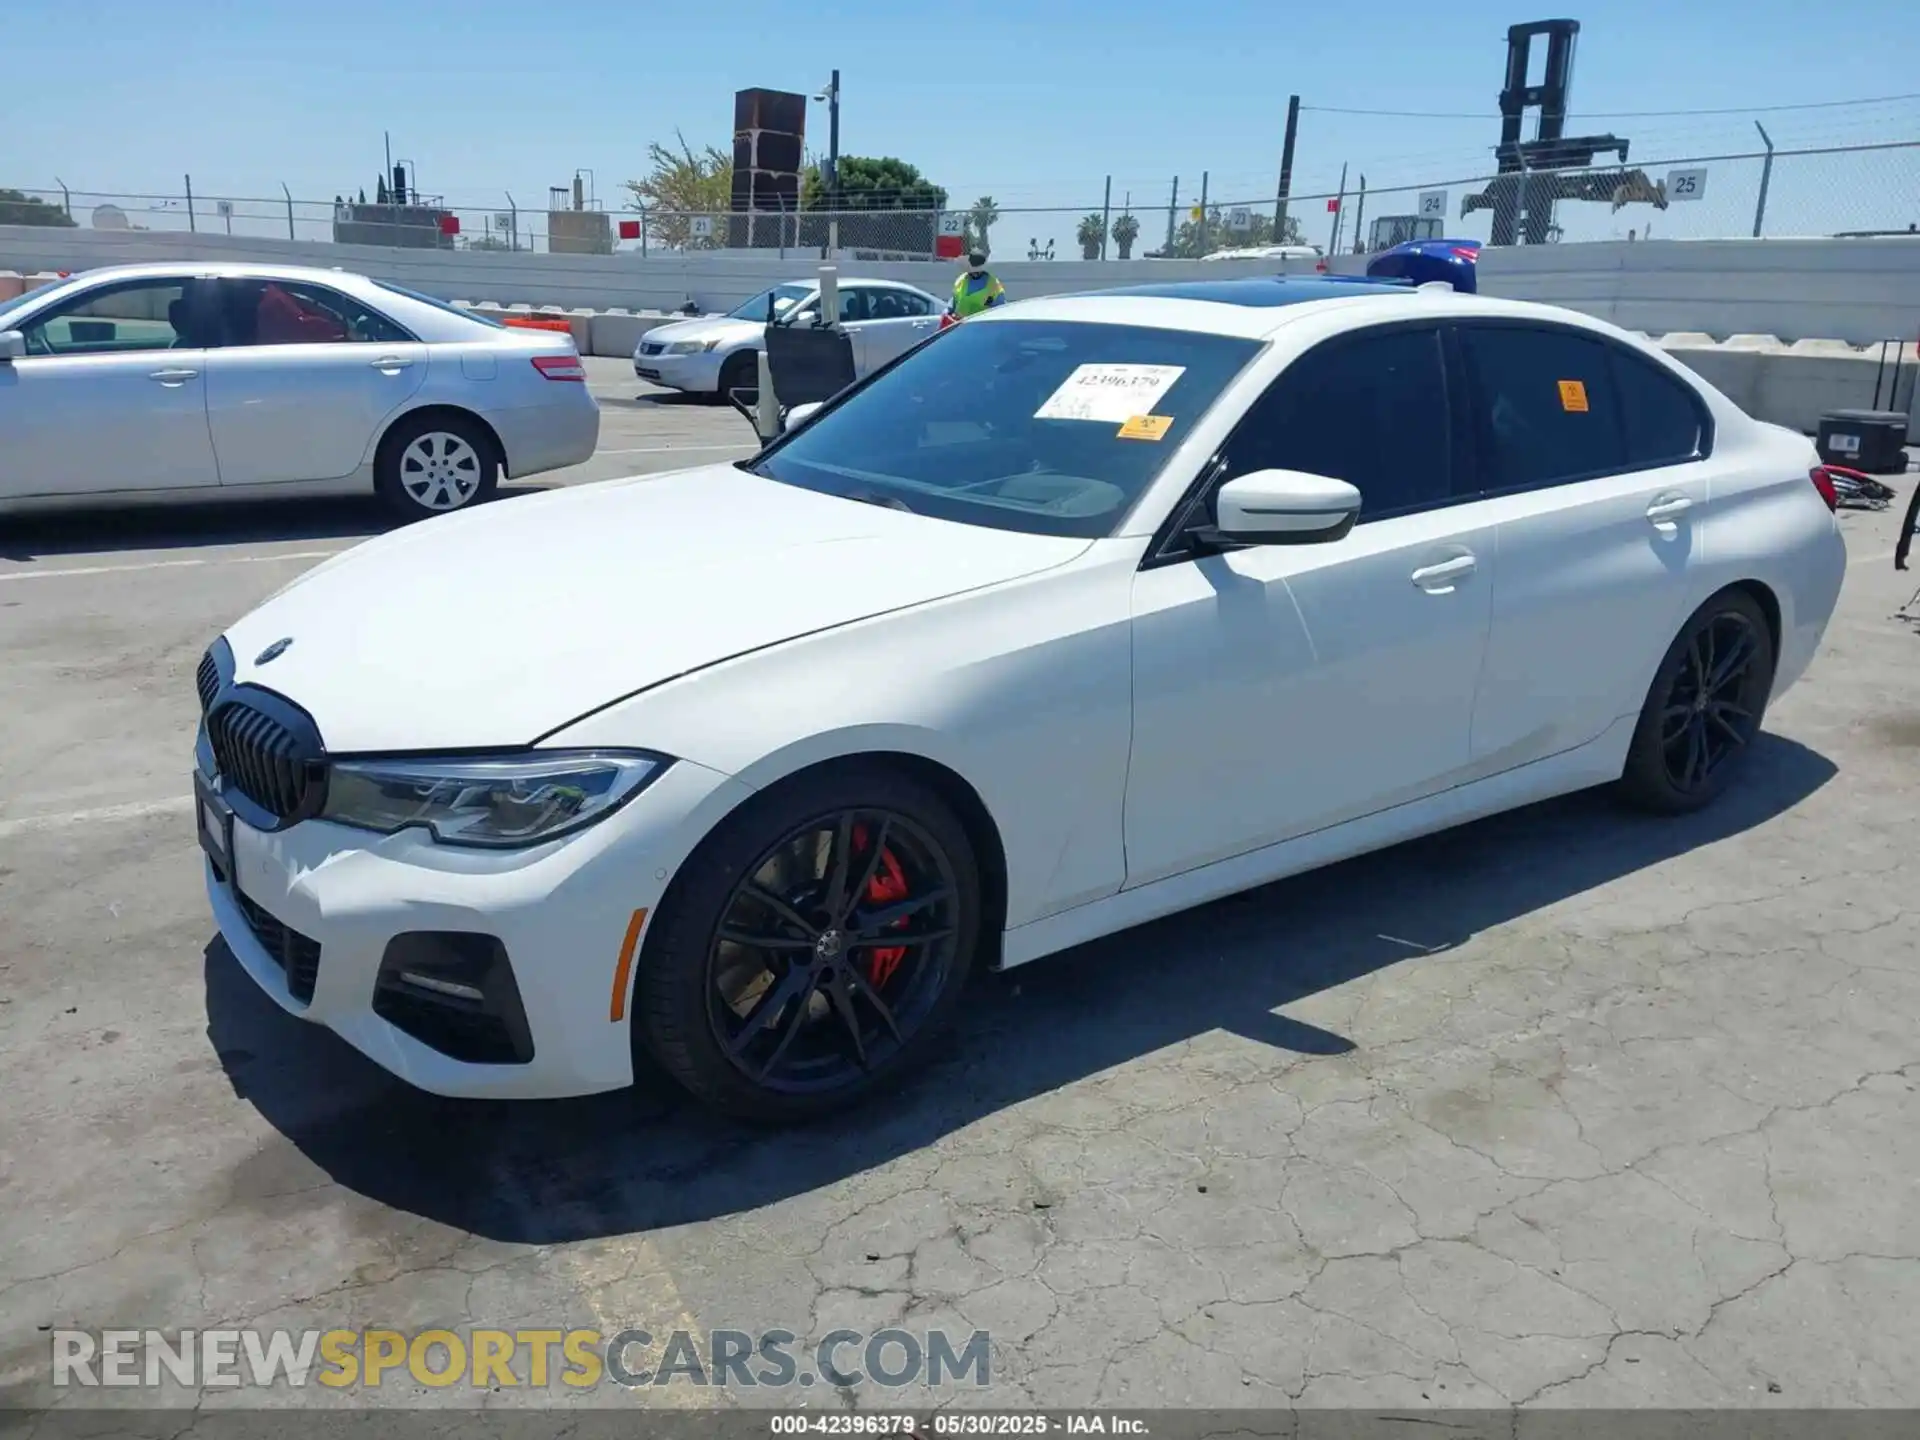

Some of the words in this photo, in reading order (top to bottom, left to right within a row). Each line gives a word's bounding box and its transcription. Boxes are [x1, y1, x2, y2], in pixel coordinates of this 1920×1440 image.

[1675, 176, 1696, 194] 25
[1425, 197, 1440, 213] 24
[499, 218, 509, 227] 20
[1235, 213, 1246, 225] 23
[696, 221, 706, 231] 21
[944, 220, 959, 231] 22
